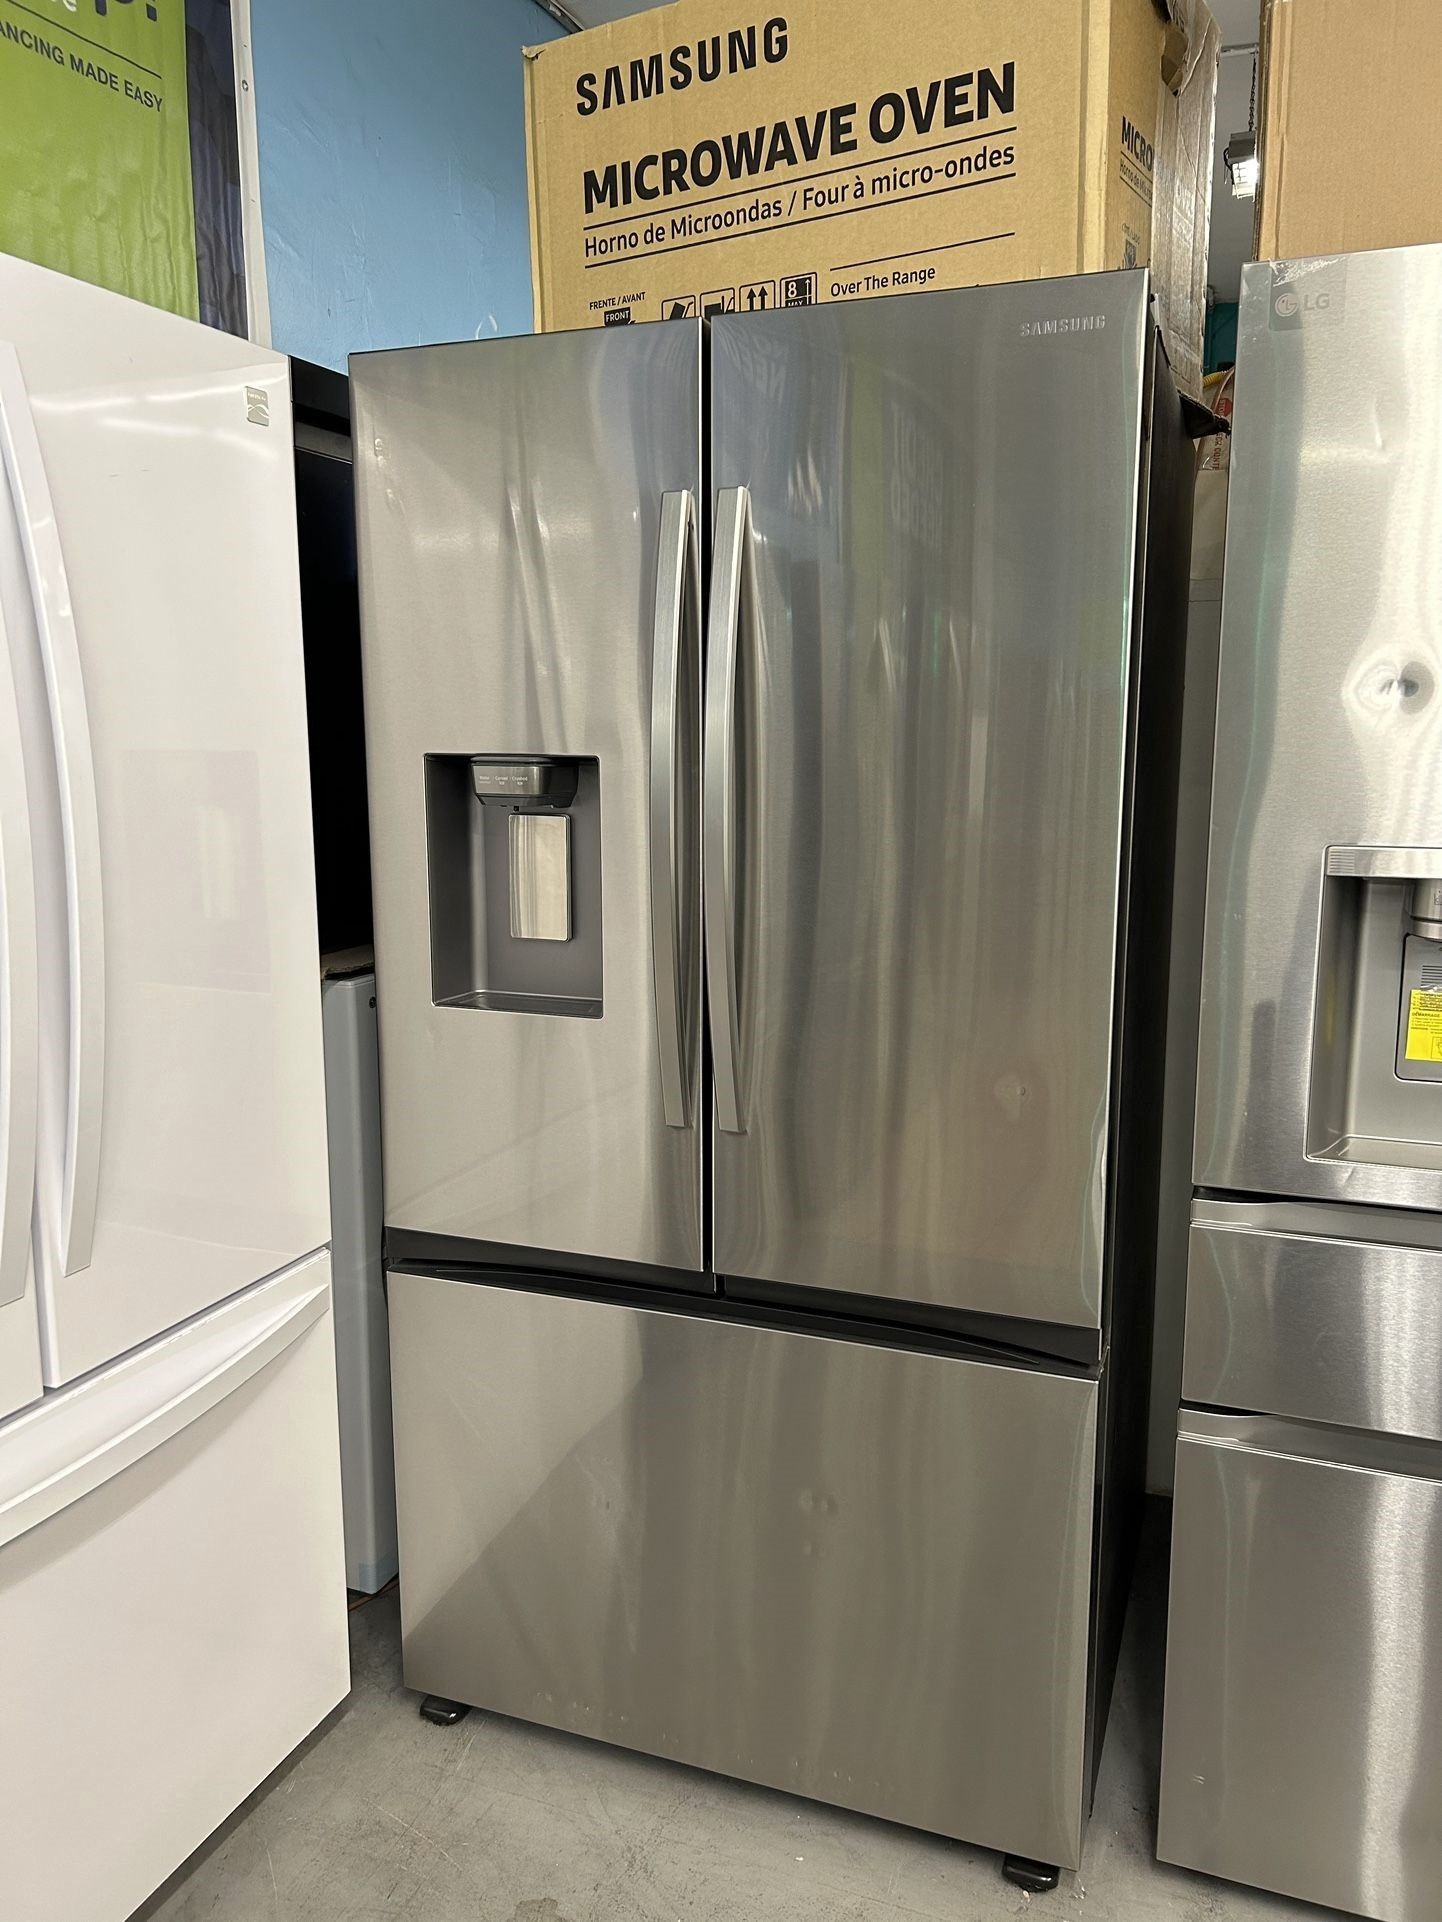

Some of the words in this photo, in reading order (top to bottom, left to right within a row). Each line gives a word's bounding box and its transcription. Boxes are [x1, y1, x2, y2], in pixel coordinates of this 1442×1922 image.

[576, 17, 788, 116] SAMSUNG
[69, 53, 119, 92] MADE
[124, 79, 163, 112] EASY
[583, 102, 858, 215] MICROWAVE
[869, 61, 1015, 144] OVEN
[585, 231, 639, 258] Horno
[643, 222, 665, 245] de
[671, 198, 782, 240] Microondas
[787, 190, 797, 217] /
[803, 184, 849, 211] Four
[853, 175, 865, 199] à
[871, 145, 1015, 196] micro-ondes
[787, 281, 798, 299] 8
[831, 280, 862, 297] Over
[864, 274, 889, 291] The
[892, 267, 936, 286] Range
[589, 297, 617, 311] FRENTE
[621, 291, 646, 305] AVANT
[1304, 293, 1330, 312] LG
[605, 310, 630, 323] FRONT
[1021, 314, 1106, 338] SAMSUNG
